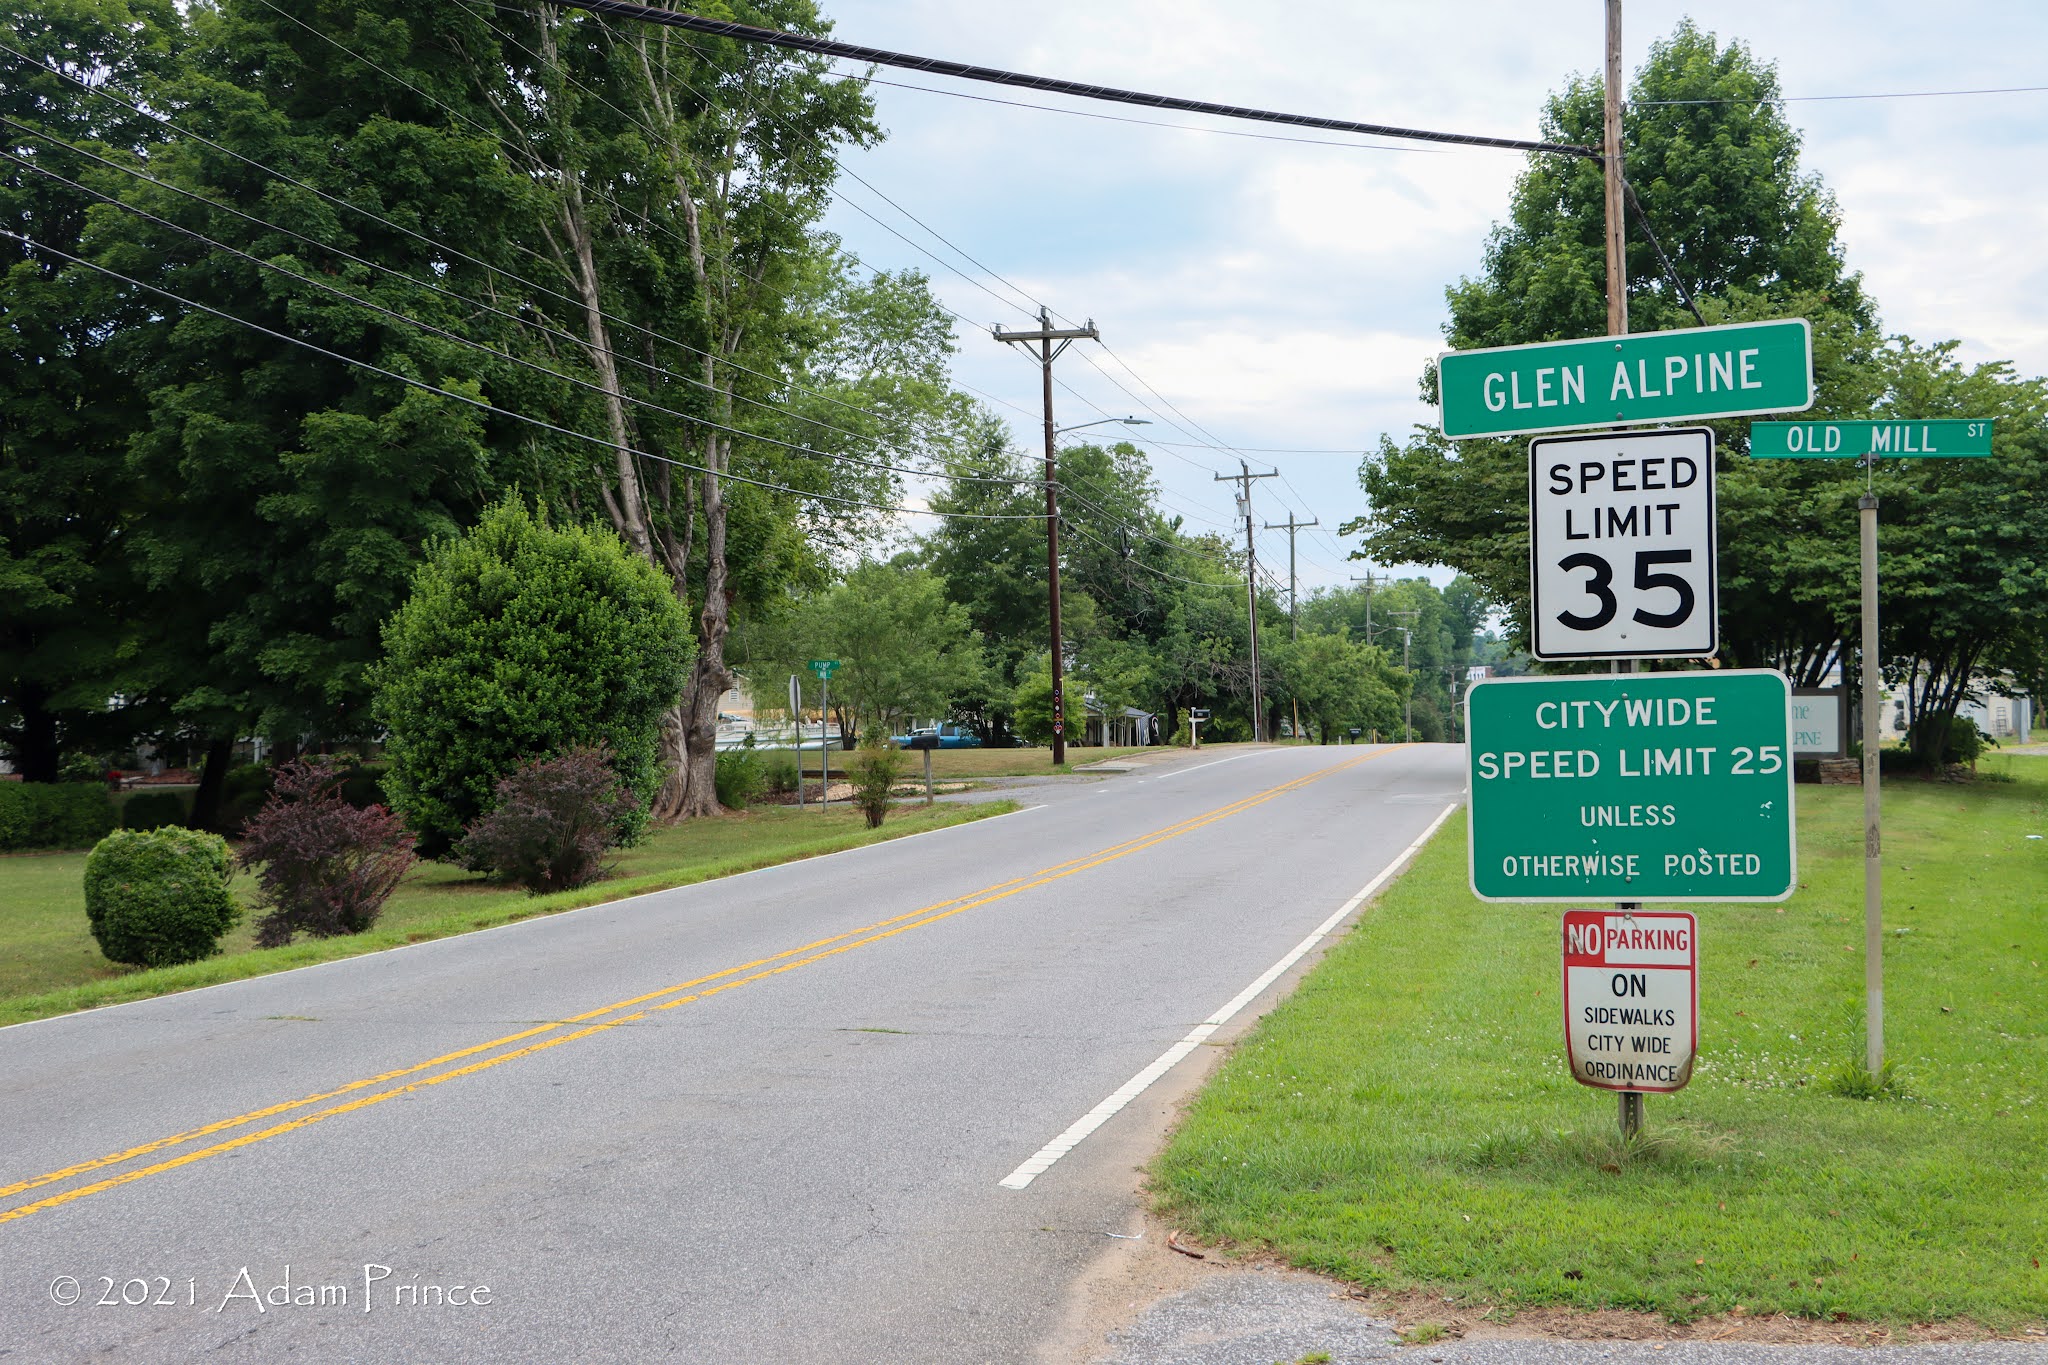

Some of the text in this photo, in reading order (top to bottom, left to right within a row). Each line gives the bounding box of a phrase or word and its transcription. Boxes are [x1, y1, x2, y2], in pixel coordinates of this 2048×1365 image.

[1483, 348, 1762, 412] GLEN ALPINE
[1787, 423, 1985, 452] OLD MILL ST
[1548, 456, 1698, 496] SPEED
[1565, 503, 1681, 541] LIMIT
[1556, 548, 1695, 632] 35
[814, 661, 831, 669] PUMP
[1535, 697, 1717, 729] CITYWIDE
[1478, 745, 1782, 780] SPEED LIMIT 25
[1581, 804, 1676, 827] UNLESS
[1502, 853, 1761, 877] OTHERWISE POSTED
[1568, 923, 1688, 956] NO PARKING
[1611, 973, 1646, 998] ON
[1584, 1006, 1675, 1027] SIDEWALKS
[1587, 1034, 1671, 1054] CITY WIDE
[1584, 1060, 1678, 1082] ORDINANCE
